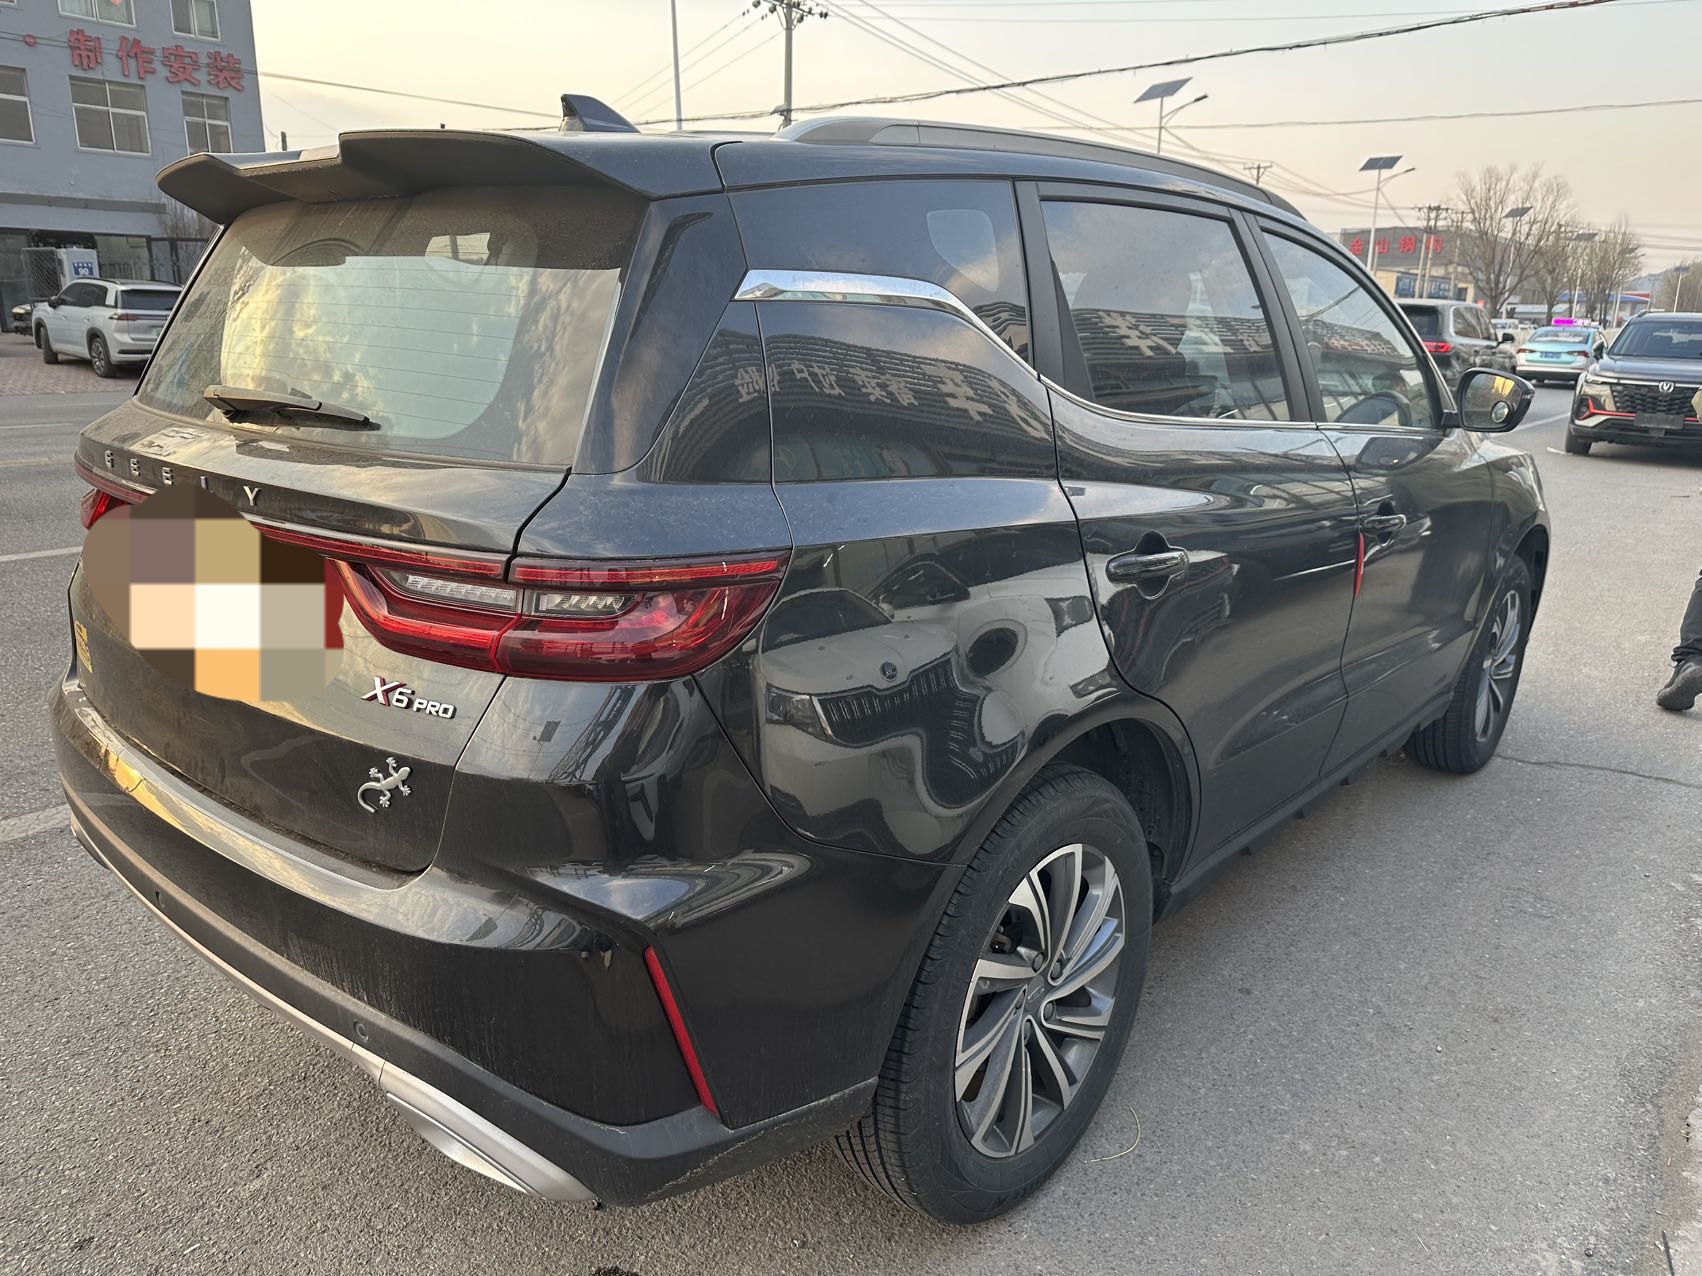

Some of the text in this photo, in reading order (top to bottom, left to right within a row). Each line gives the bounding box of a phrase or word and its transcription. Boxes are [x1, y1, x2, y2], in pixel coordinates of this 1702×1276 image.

[68, 28, 245, 91] 制作安装
[79, 267, 89, 276] 90
[361, 675, 457, 719] X6 PRO
